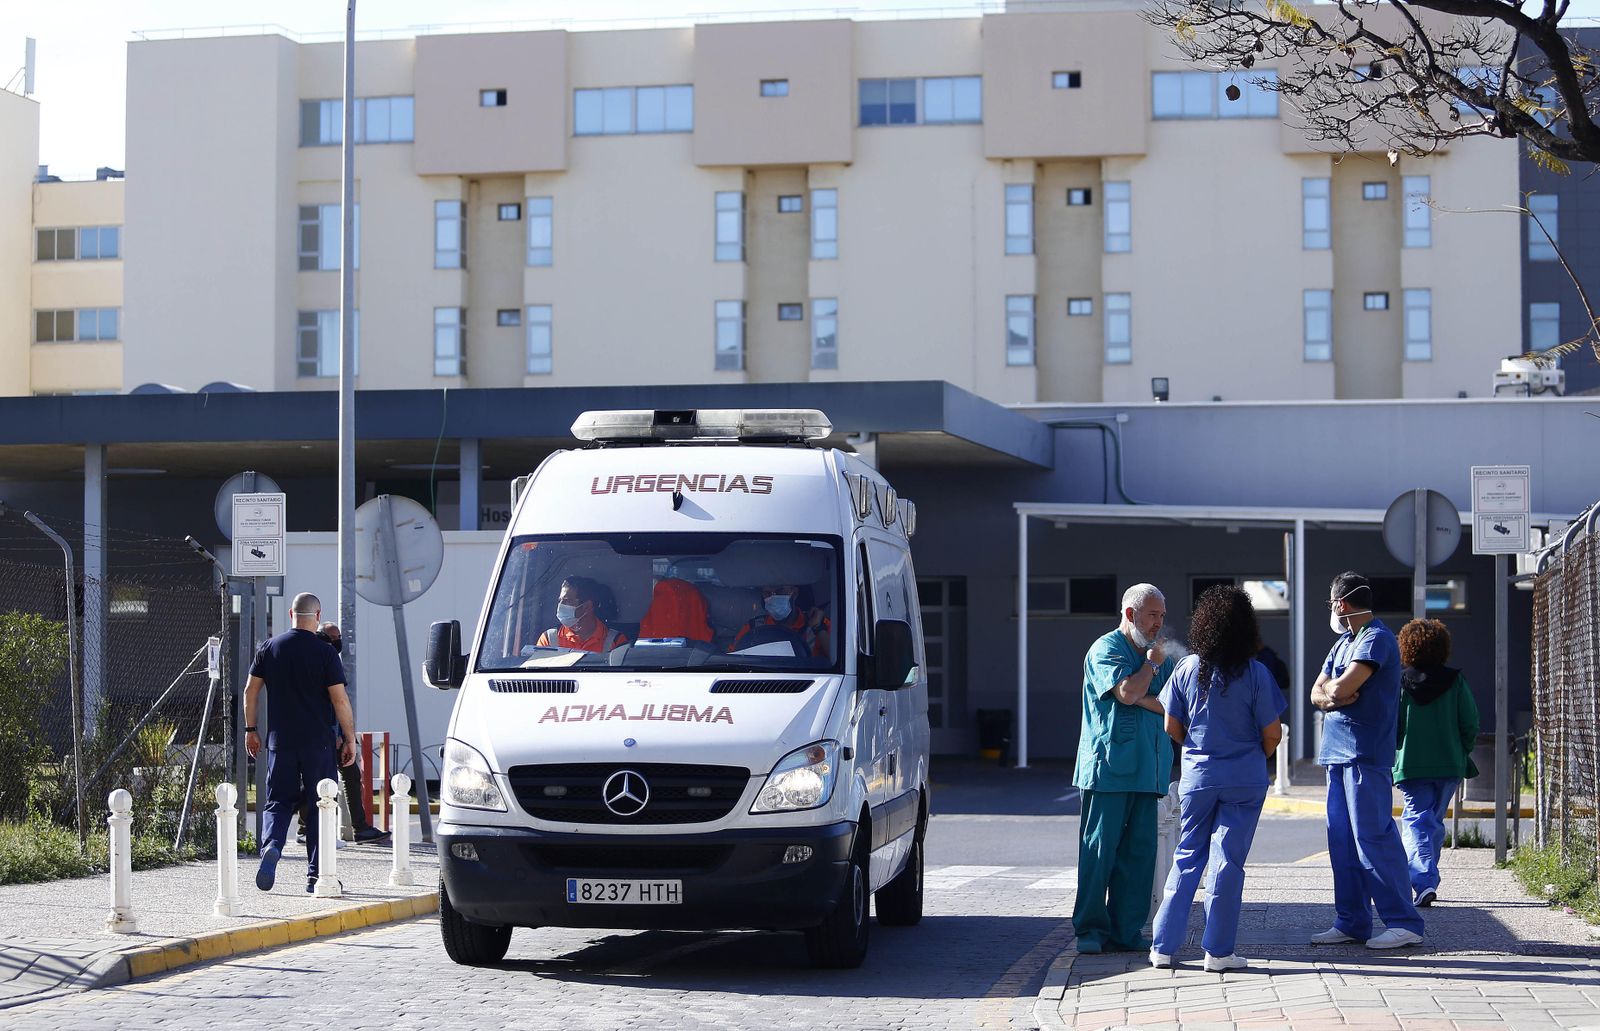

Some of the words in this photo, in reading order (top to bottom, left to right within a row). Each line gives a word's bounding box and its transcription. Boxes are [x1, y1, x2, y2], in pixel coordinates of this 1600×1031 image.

[590, 474, 774, 495] URGENCIAS
[481, 507, 512, 522] Hos
[581, 882, 632, 901] 8237
[640, 883, 678, 901] HTH
